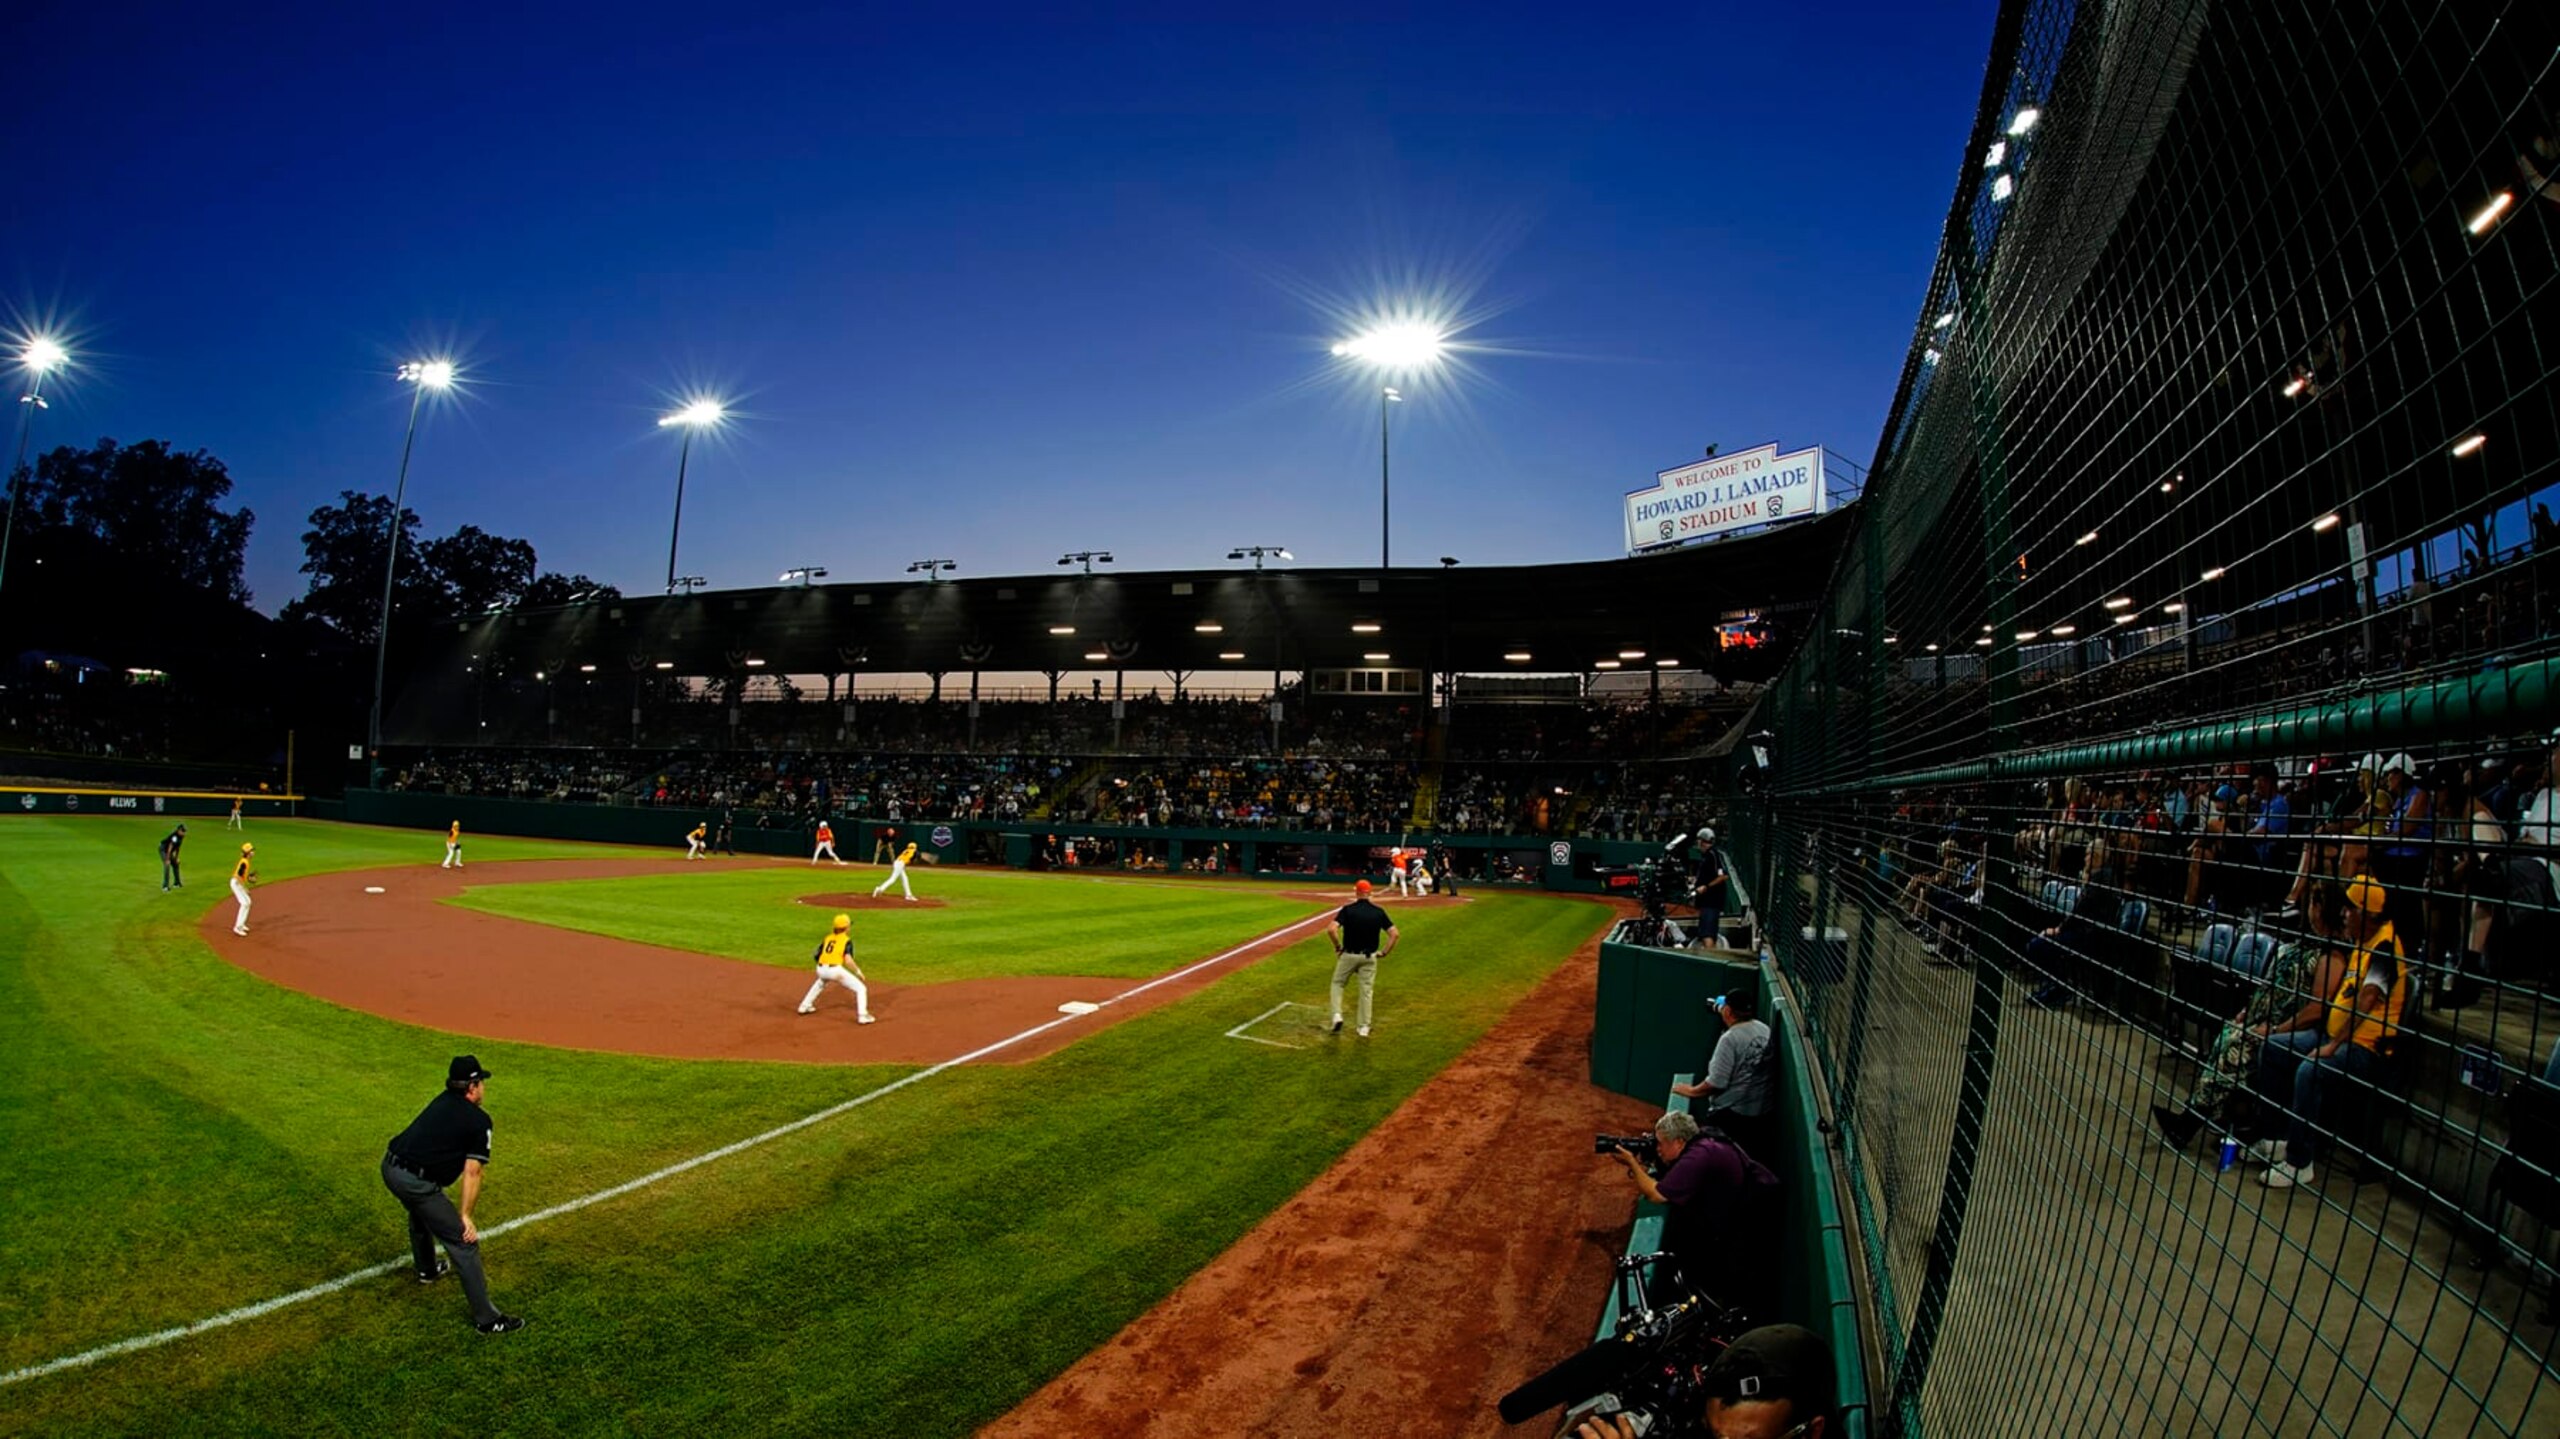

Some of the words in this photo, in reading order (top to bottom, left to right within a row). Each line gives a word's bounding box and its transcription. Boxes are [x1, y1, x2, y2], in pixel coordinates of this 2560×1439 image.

[1675, 463, 1738, 488] WELCOME
[1743, 458, 1761, 472] TO
[1636, 490, 1708, 521] HOWARD
[1712, 487, 1723, 504] J.
[1728, 466, 1808, 501] LAMADE
[1679, 501, 1757, 532] STADIUM
[109, 796, 137, 808] #LLWS
[825, 940, 837, 954] 6
